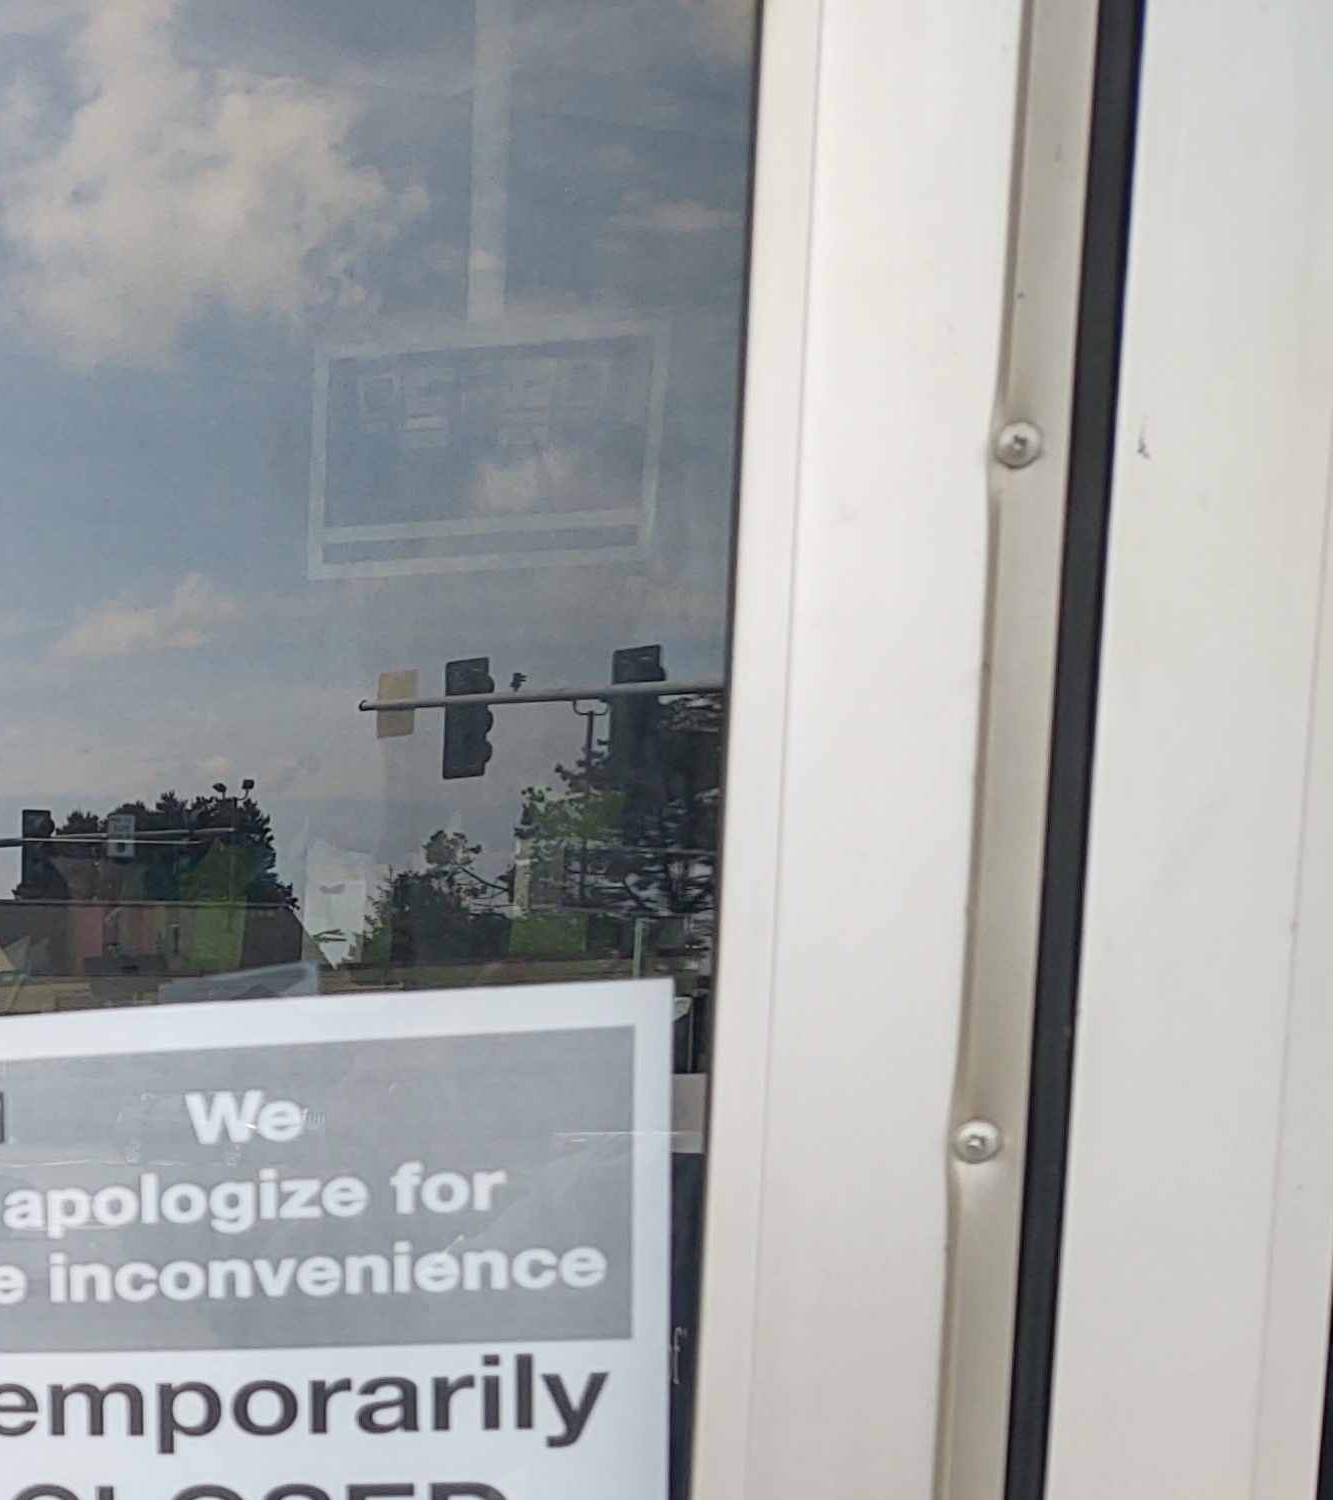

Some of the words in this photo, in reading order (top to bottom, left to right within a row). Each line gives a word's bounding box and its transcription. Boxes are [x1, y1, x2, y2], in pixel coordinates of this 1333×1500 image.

[184, 1090, 303, 1145] We
[3, 1168, 368, 1239] apologize
[390, 1160, 507, 1215] for
[49, 1242, 607, 1304] inconvenience
